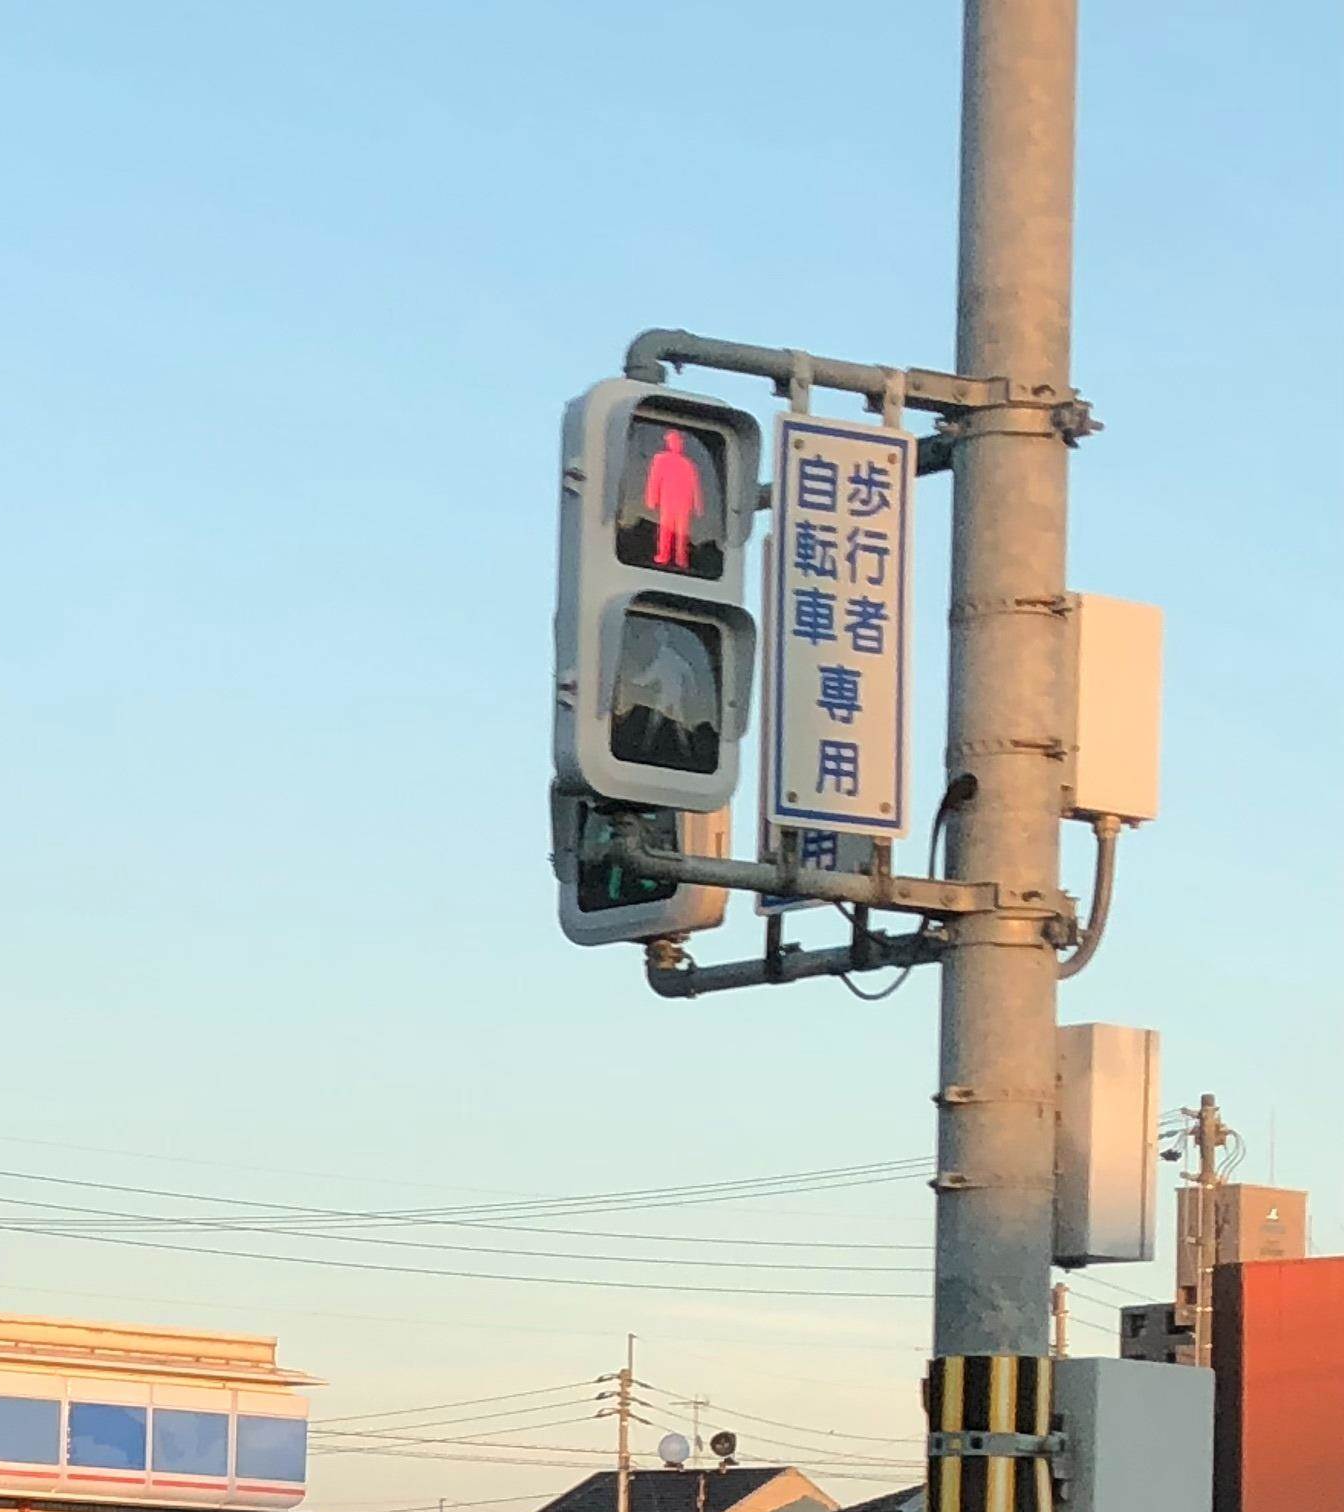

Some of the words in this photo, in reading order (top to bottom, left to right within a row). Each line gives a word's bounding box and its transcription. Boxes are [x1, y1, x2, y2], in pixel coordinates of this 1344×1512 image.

[792, 453, 838, 646] 自転車
[844, 459, 892, 655] 歩行者
[815, 663, 863, 797] 専用
